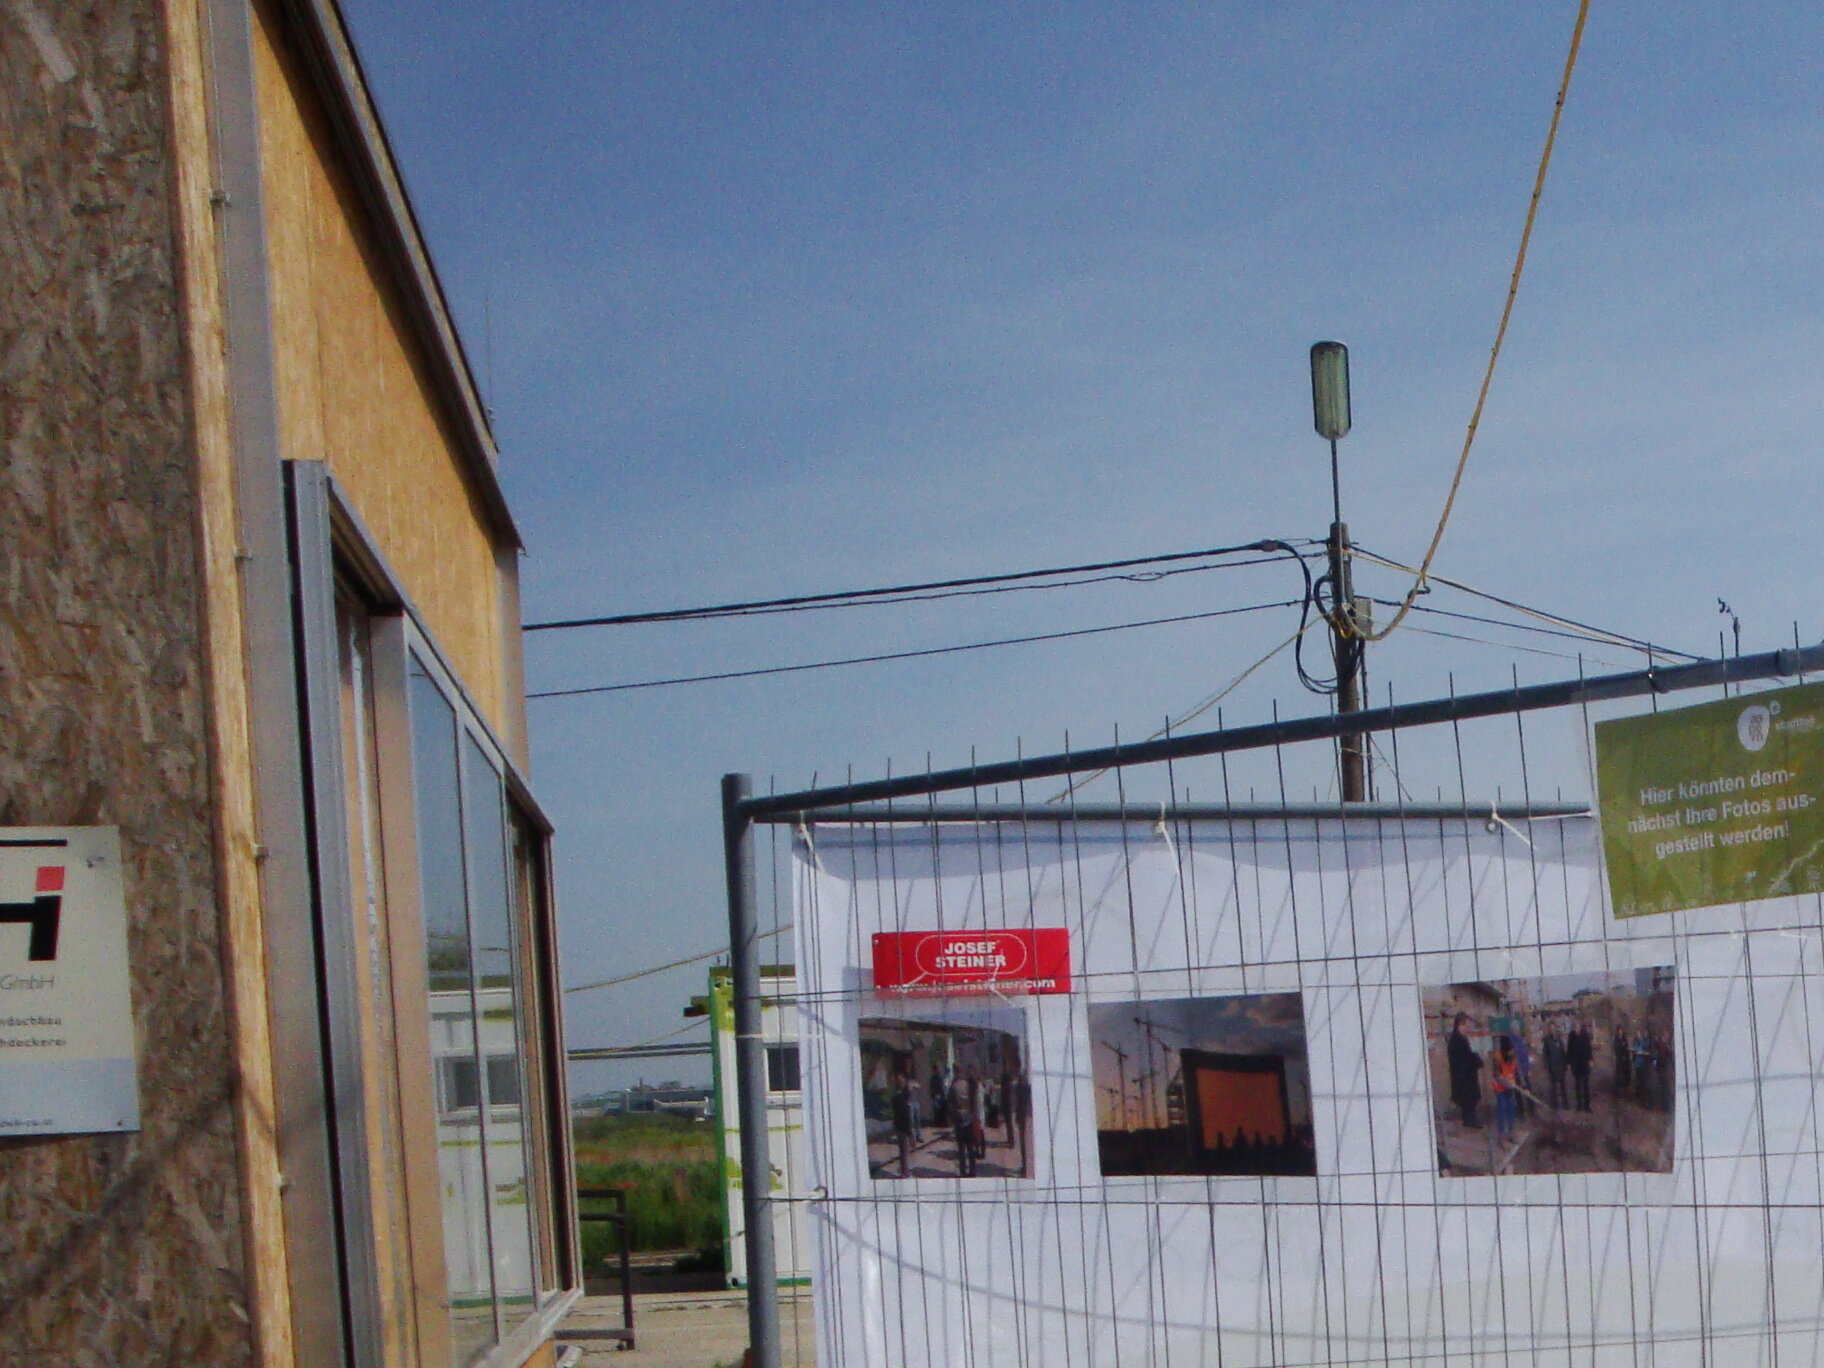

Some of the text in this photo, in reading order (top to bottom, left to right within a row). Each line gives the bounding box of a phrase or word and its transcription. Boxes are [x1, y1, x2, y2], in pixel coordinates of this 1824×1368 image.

[1640, 769, 1796, 806] Hier könnten dem-
[1686, 807, 1718, 825] Ihre
[1722, 798, 1771, 820] Fotos
[1776, 792, 1817, 811] aus-
[1655, 831, 1716, 860] gestellt
[935, 954, 1006, 969] STEINER
[944, 941, 997, 955] JOSEF
